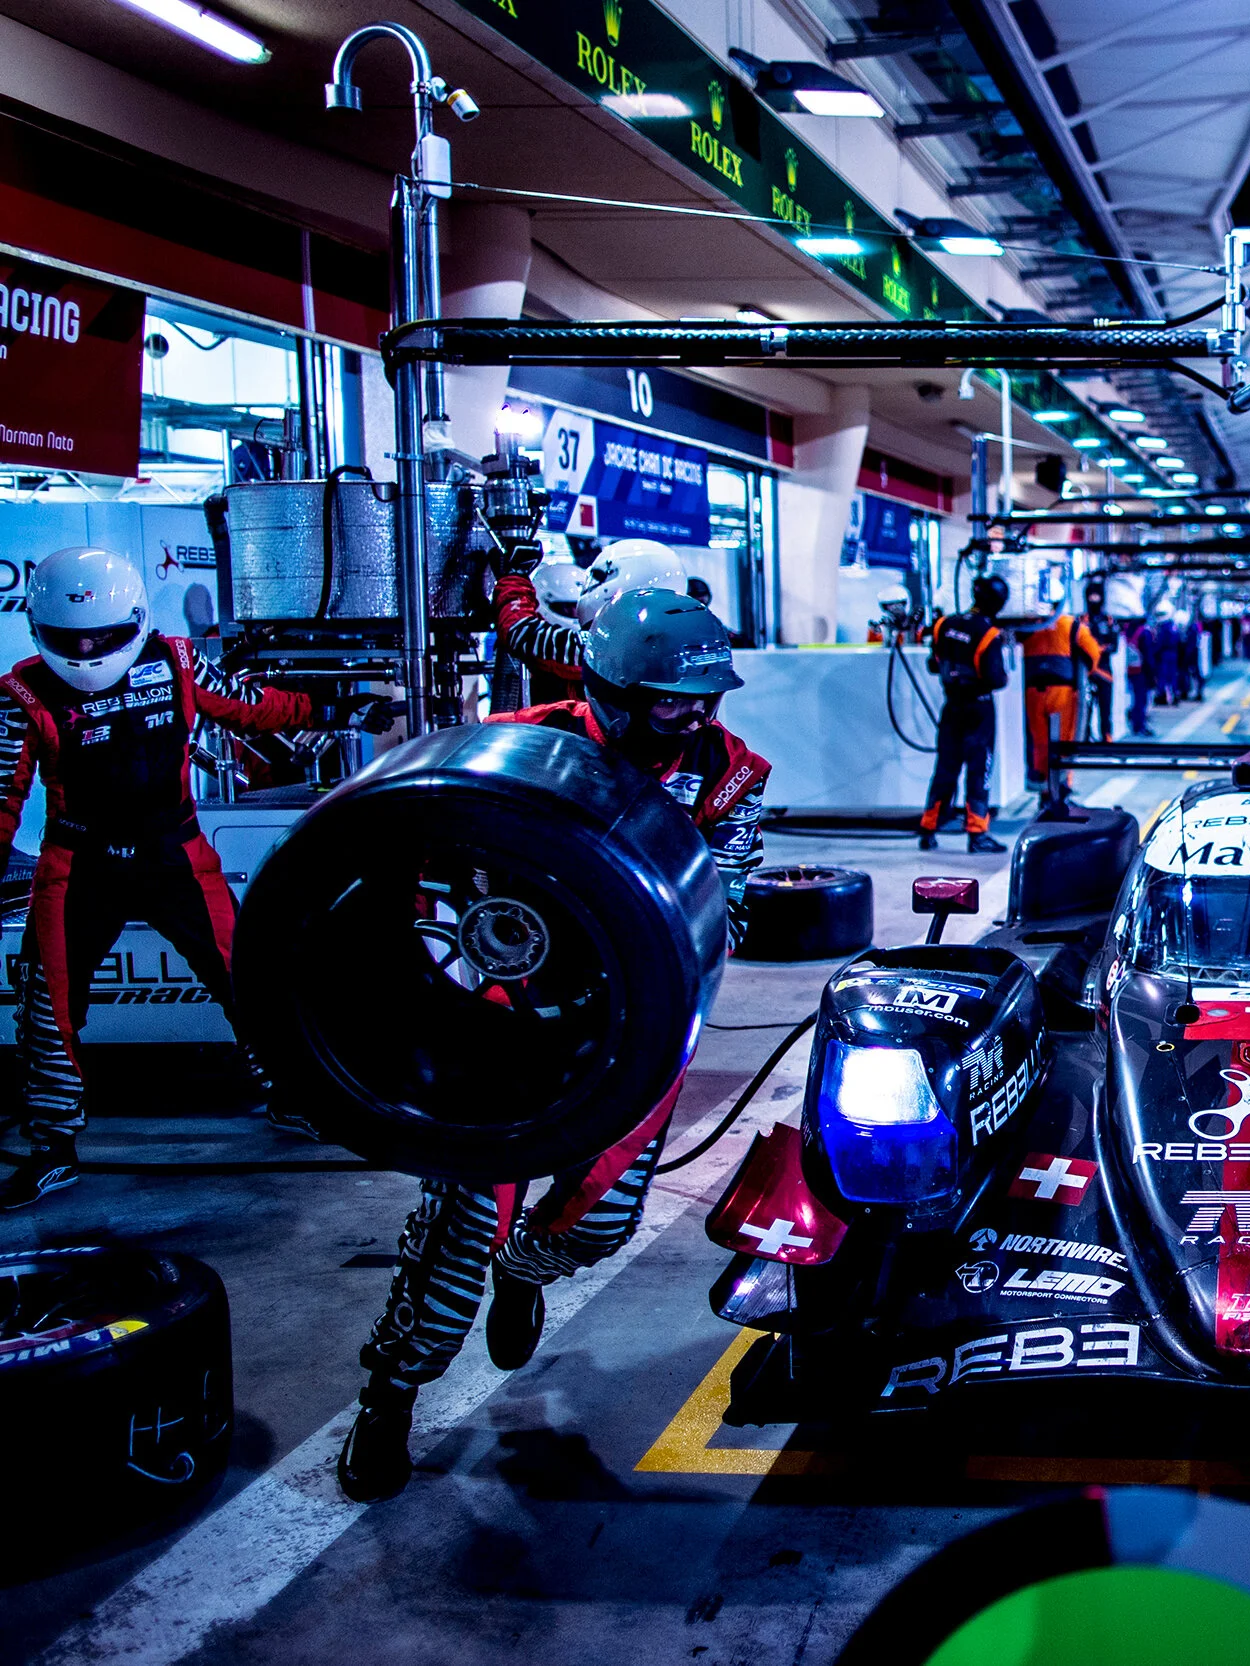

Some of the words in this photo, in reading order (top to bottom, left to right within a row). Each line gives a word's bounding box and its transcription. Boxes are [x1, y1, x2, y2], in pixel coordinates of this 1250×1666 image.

[576, 31, 648, 115] ROLEX
[690, 120, 744, 188] ROLEX
[772, 184, 813, 238] ROLEX
[626, 368, 654, 418] 10
[47, 431, 74, 452] Nato
[558, 427, 580, 472] 37
[144, 710, 175, 729] TVR
[713, 765, 754, 811] sparco
[868, 1005, 970, 1028] mouser.com
[969, 1070, 1004, 1100] RACING
[999, 1233, 1127, 1267] NORTHWIRE
[1000, 1290, 1053, 1299] MOTORSPORT
[1054, 1293, 1109, 1305] CONNECTORS
[1003, 1268, 1126, 1297] LEMO
